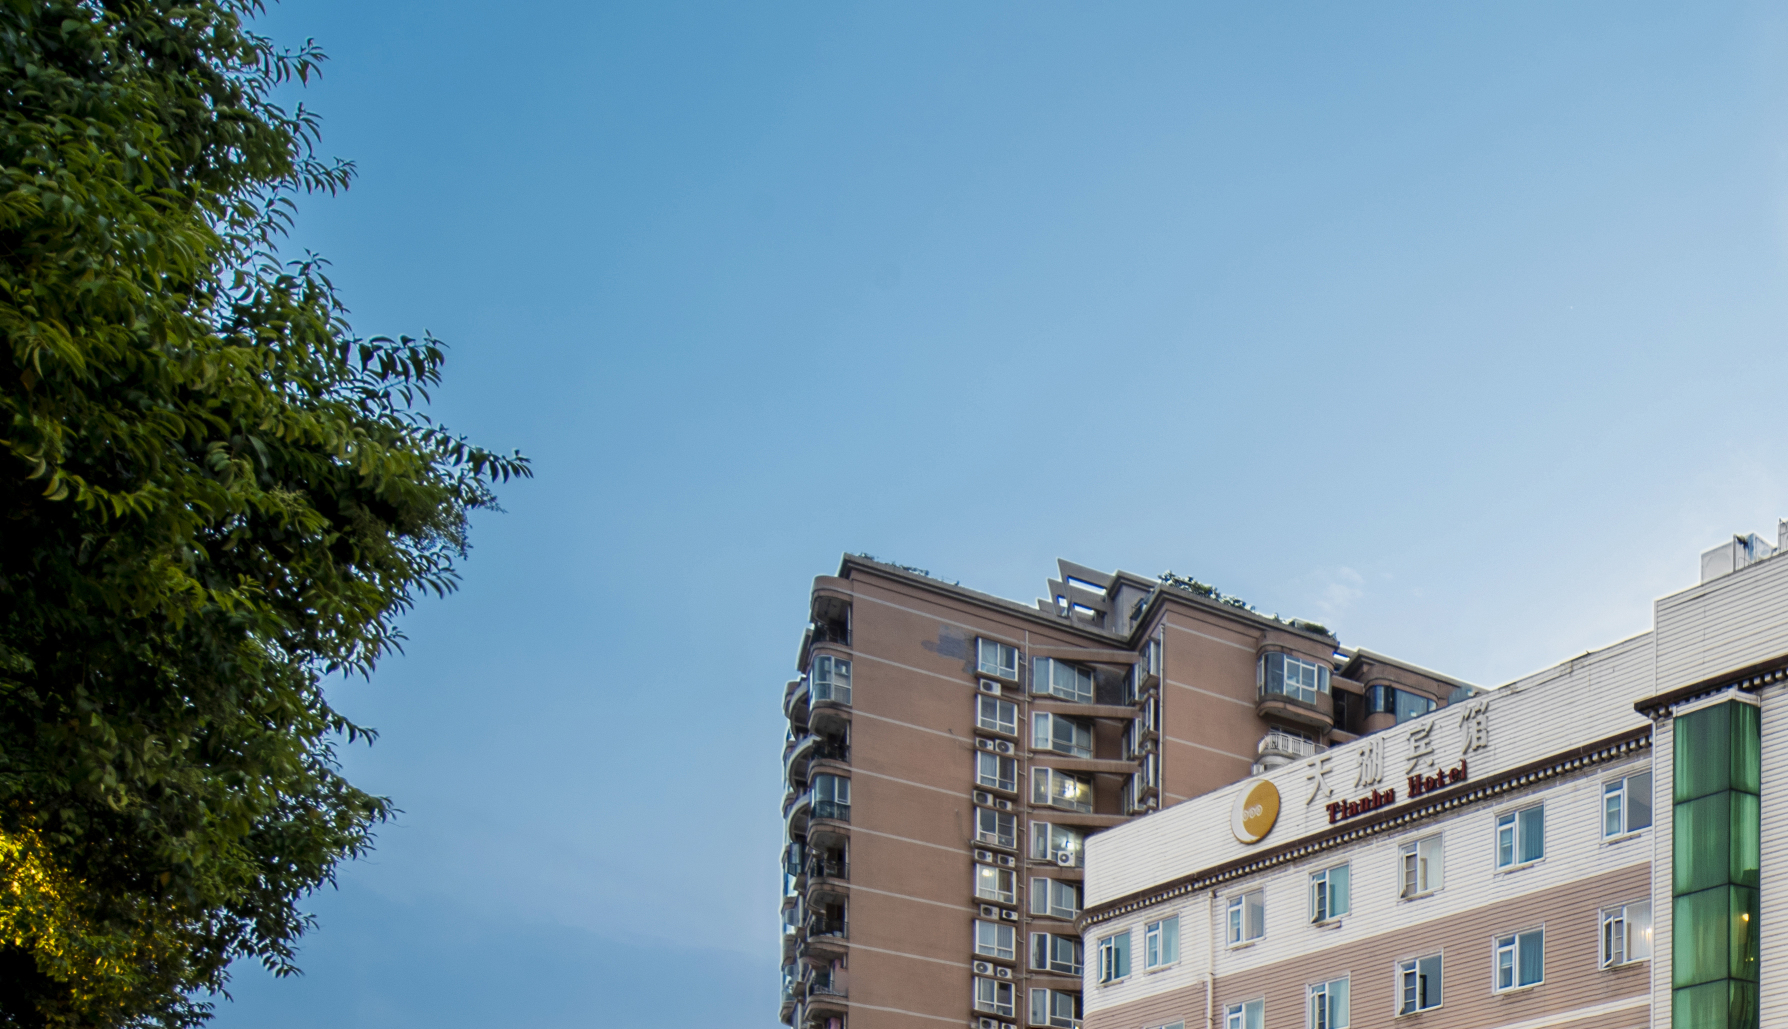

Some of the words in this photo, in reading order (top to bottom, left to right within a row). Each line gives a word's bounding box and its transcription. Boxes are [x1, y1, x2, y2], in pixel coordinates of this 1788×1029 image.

[1306, 700, 1490, 805] 天湖宾馆
[1326, 787, 1395, 824] Tianhu
[1407, 758, 1467, 798] Hotel
